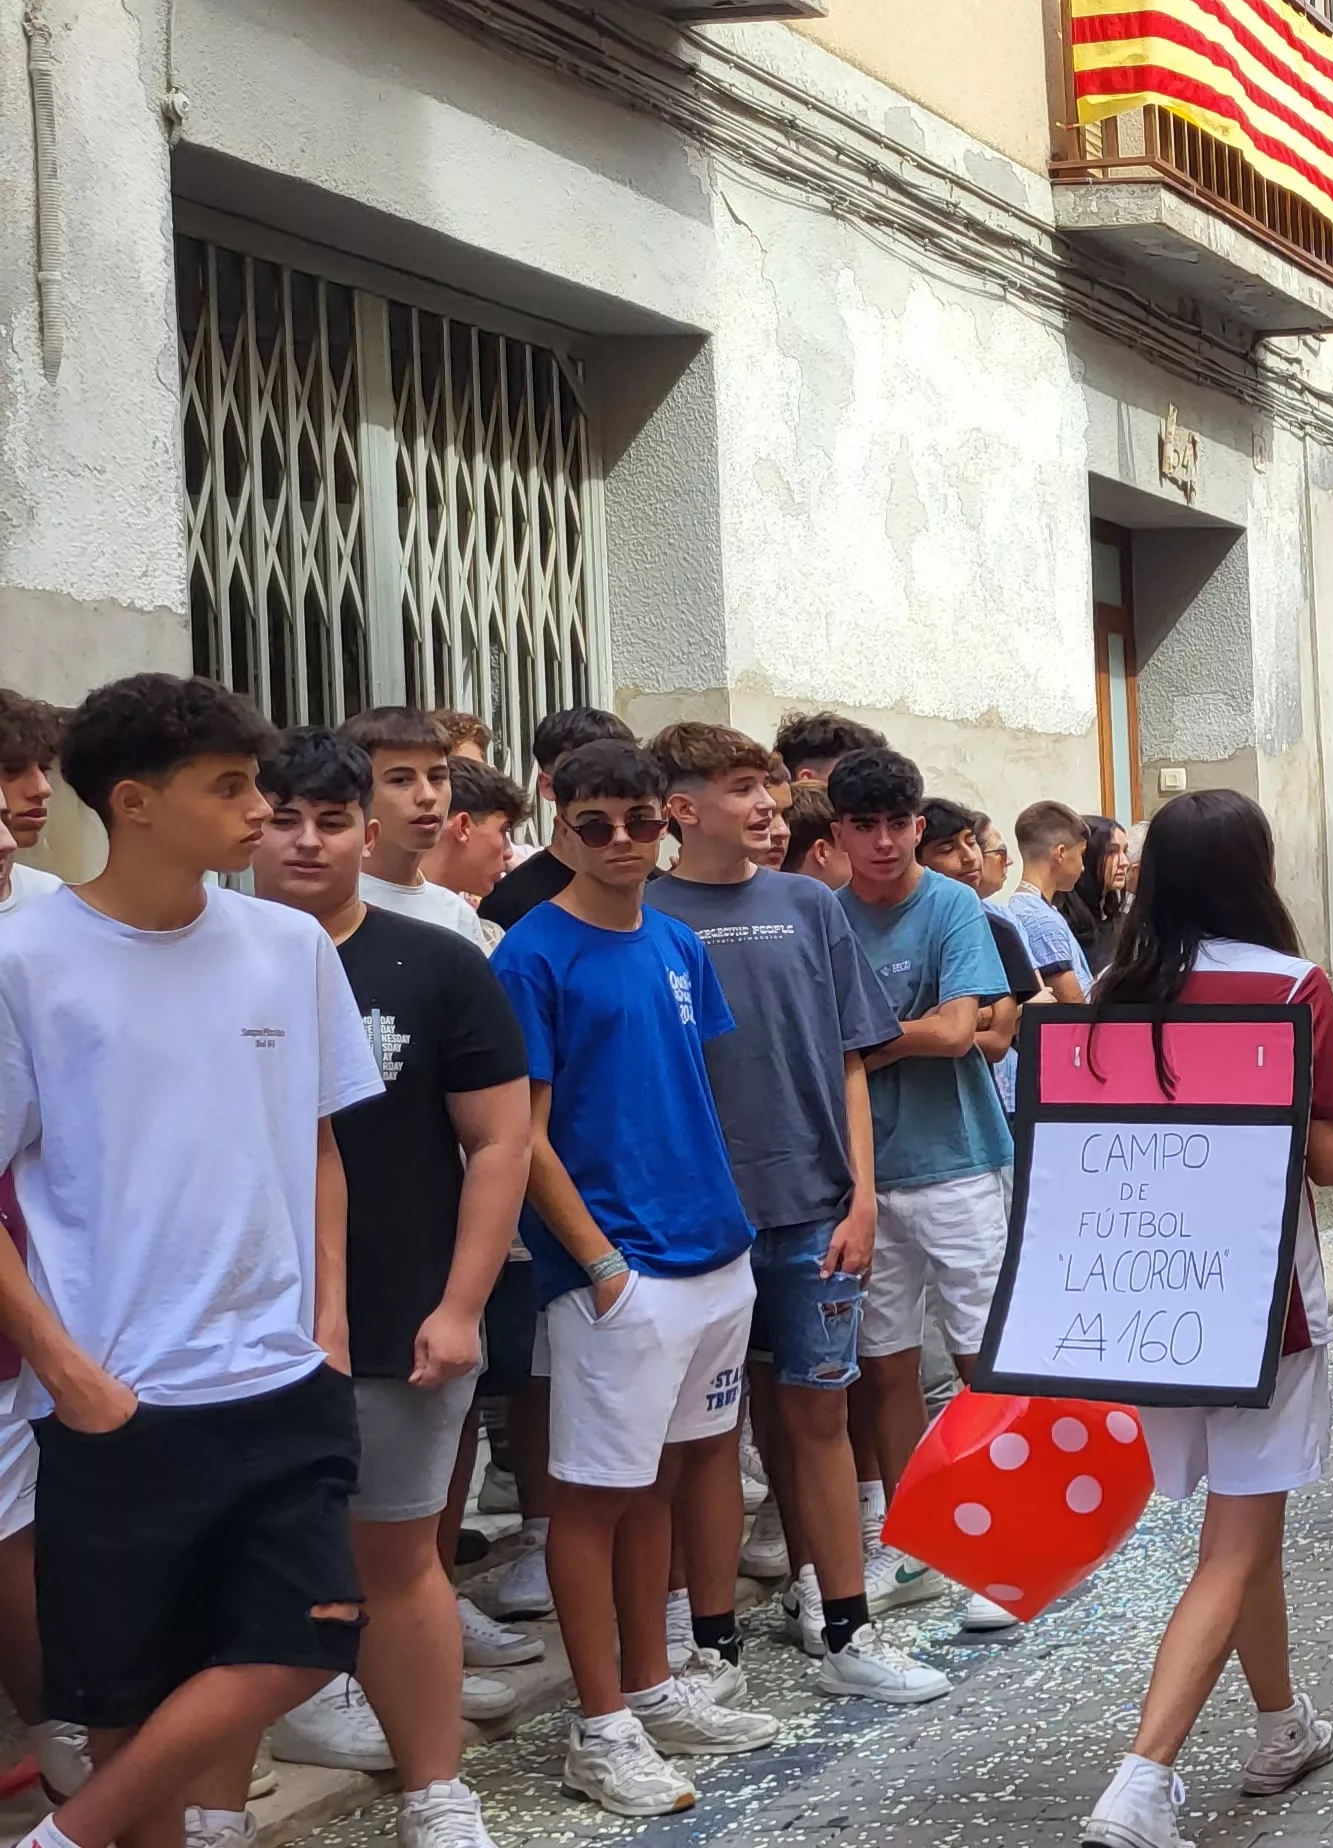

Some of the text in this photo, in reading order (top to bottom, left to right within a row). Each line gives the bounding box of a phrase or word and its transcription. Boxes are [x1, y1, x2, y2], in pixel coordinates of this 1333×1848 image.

[1081, 1132, 1210, 1174] CAMPO
[1119, 1182, 1150, 1202] DE
[1079, 1207, 1192, 1238] FÚTBOL
